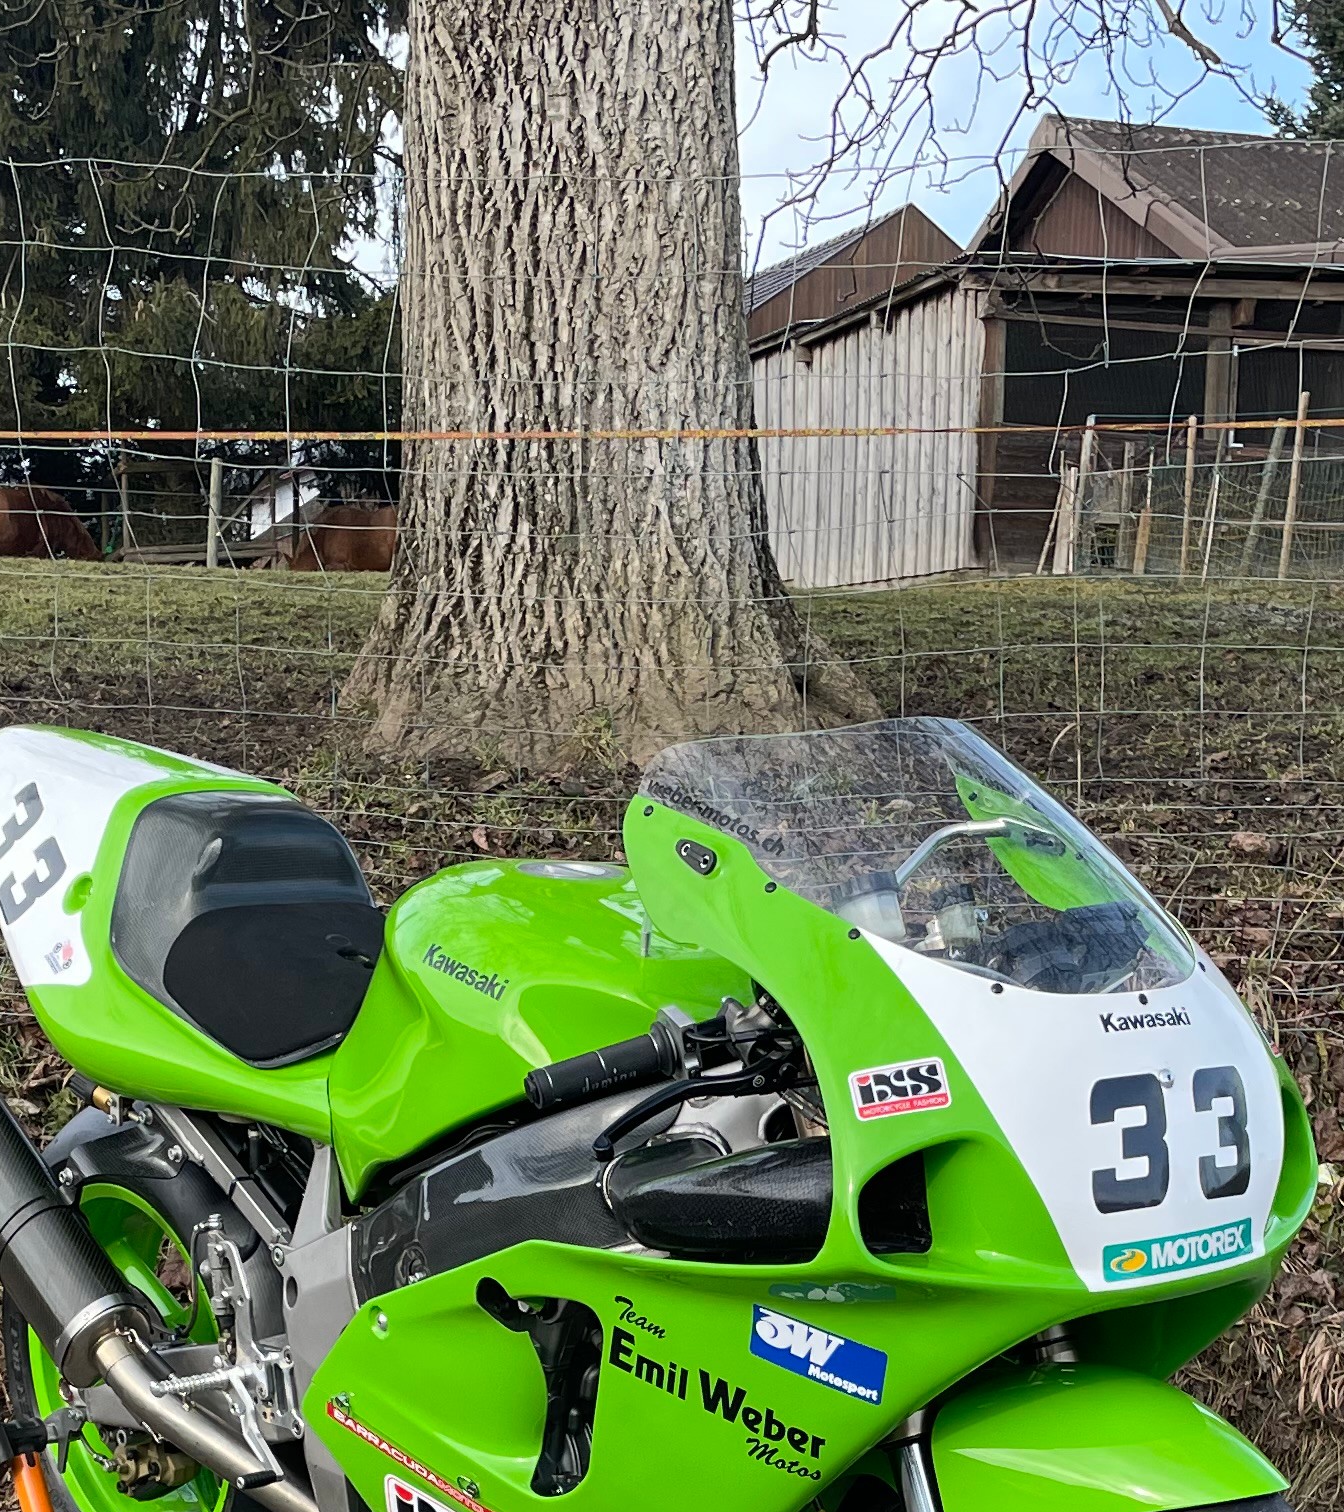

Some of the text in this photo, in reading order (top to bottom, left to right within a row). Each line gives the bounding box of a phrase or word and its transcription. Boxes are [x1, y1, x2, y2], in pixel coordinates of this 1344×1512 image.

[422, 943, 509, 1001] Kawasaki
[1099, 1006, 1191, 1033] Kawasaki
[1090, 1066, 1251, 1214] 33
[1151, 1224, 1247, 1270] MOTOREX
[614, 1295, 666, 1339] Team
[609, 1325, 826, 1459] Emil Weber
[808, 1363, 878, 1401] Motosport
[746, 1437, 821, 1480] Motos
